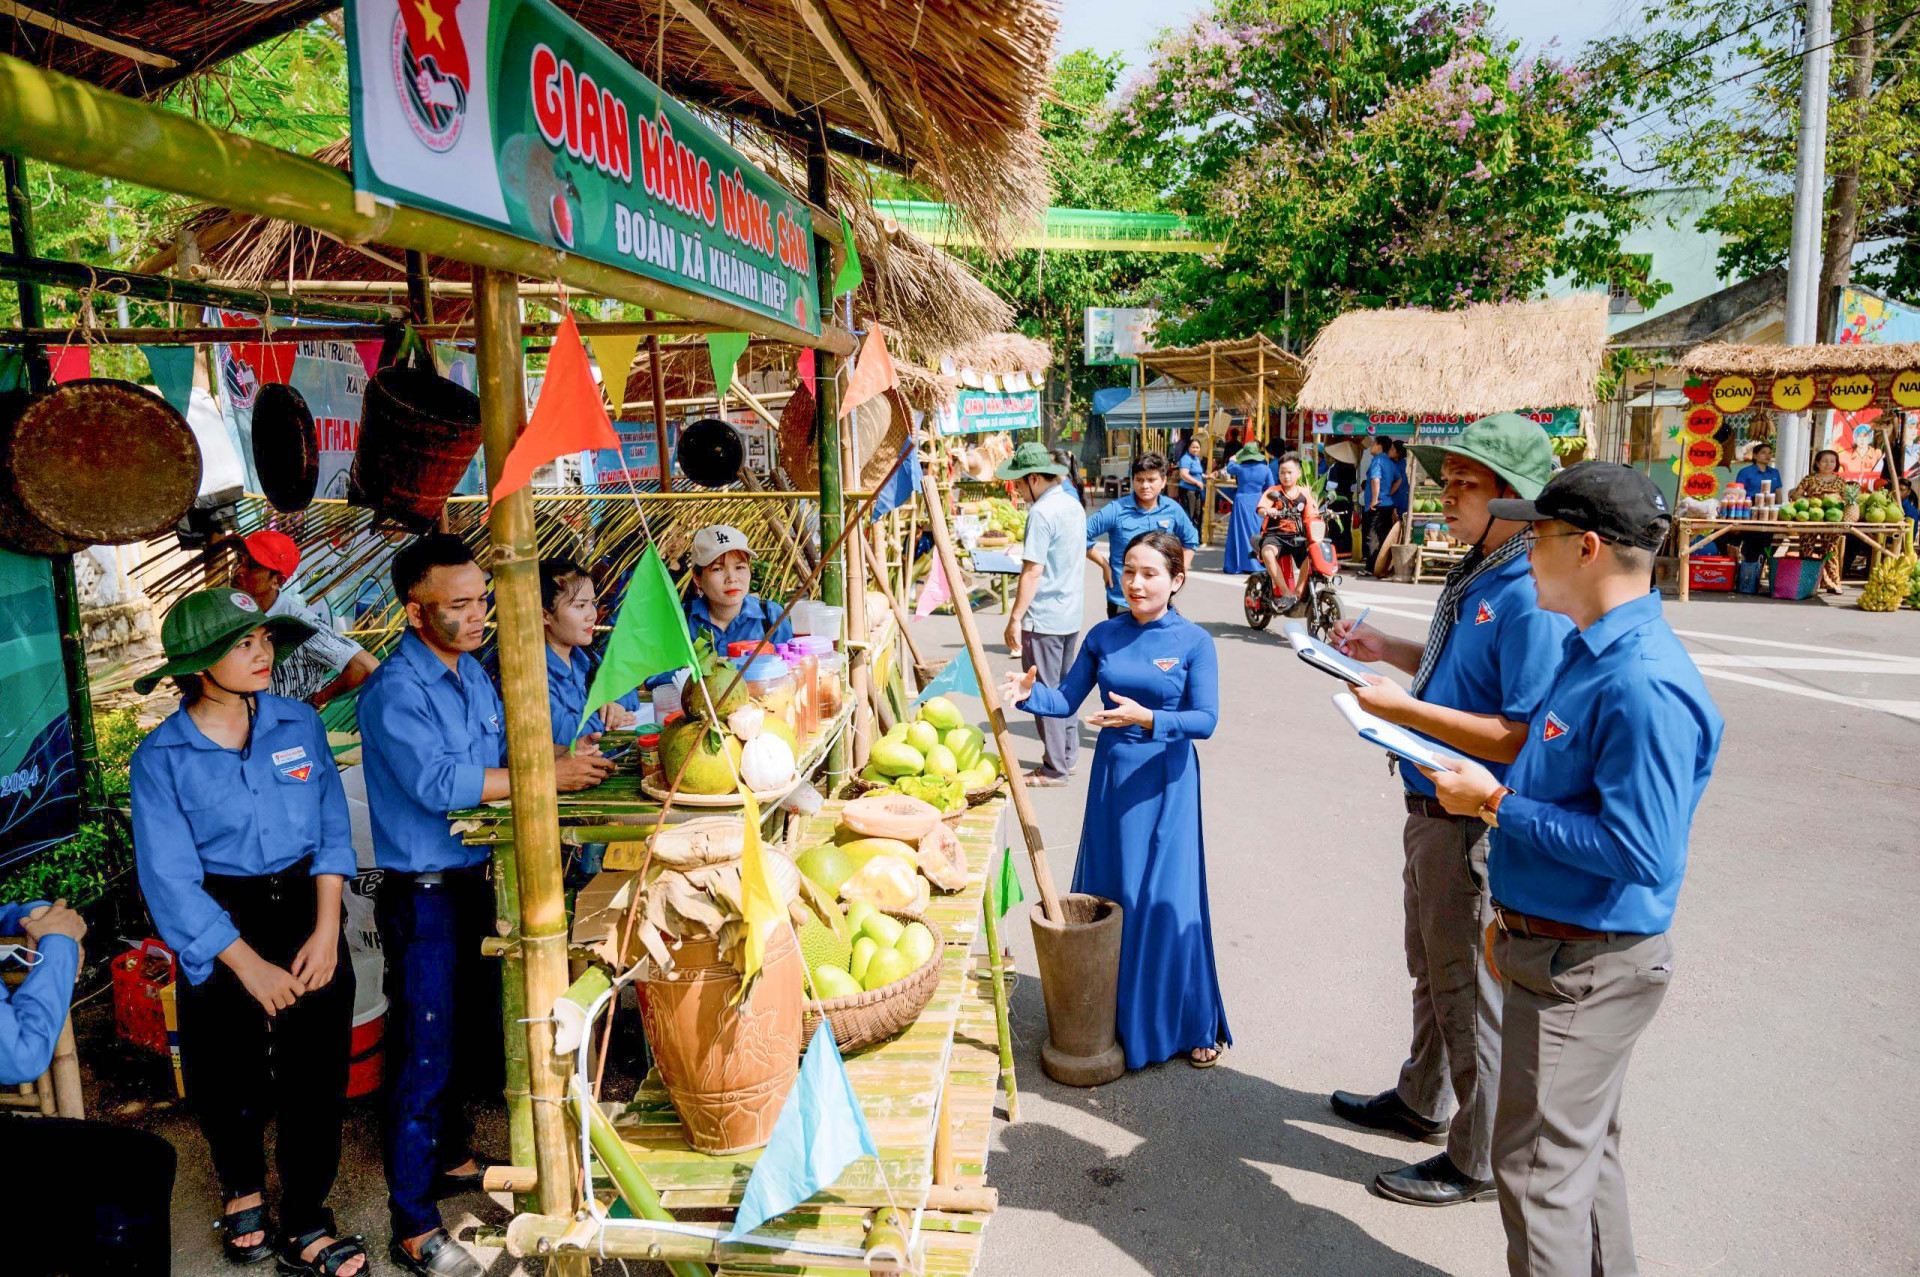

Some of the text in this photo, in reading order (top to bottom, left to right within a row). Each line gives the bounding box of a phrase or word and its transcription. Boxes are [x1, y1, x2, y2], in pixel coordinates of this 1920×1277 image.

[531, 43, 632, 183] GIAN
[639, 110, 717, 228] HÀNG
[718, 166, 774, 260] NÔNG
[777, 200, 810, 277] SẢN
[615, 203, 787, 317] ĐOÀN XÃ KHÁNH HIỆP
[1715, 381, 1920, 398] ĐOÀN XÃ KHÁNH NA
[1369, 413, 1408, 425] GIAN
[0, 764, 39, 798] 2024
